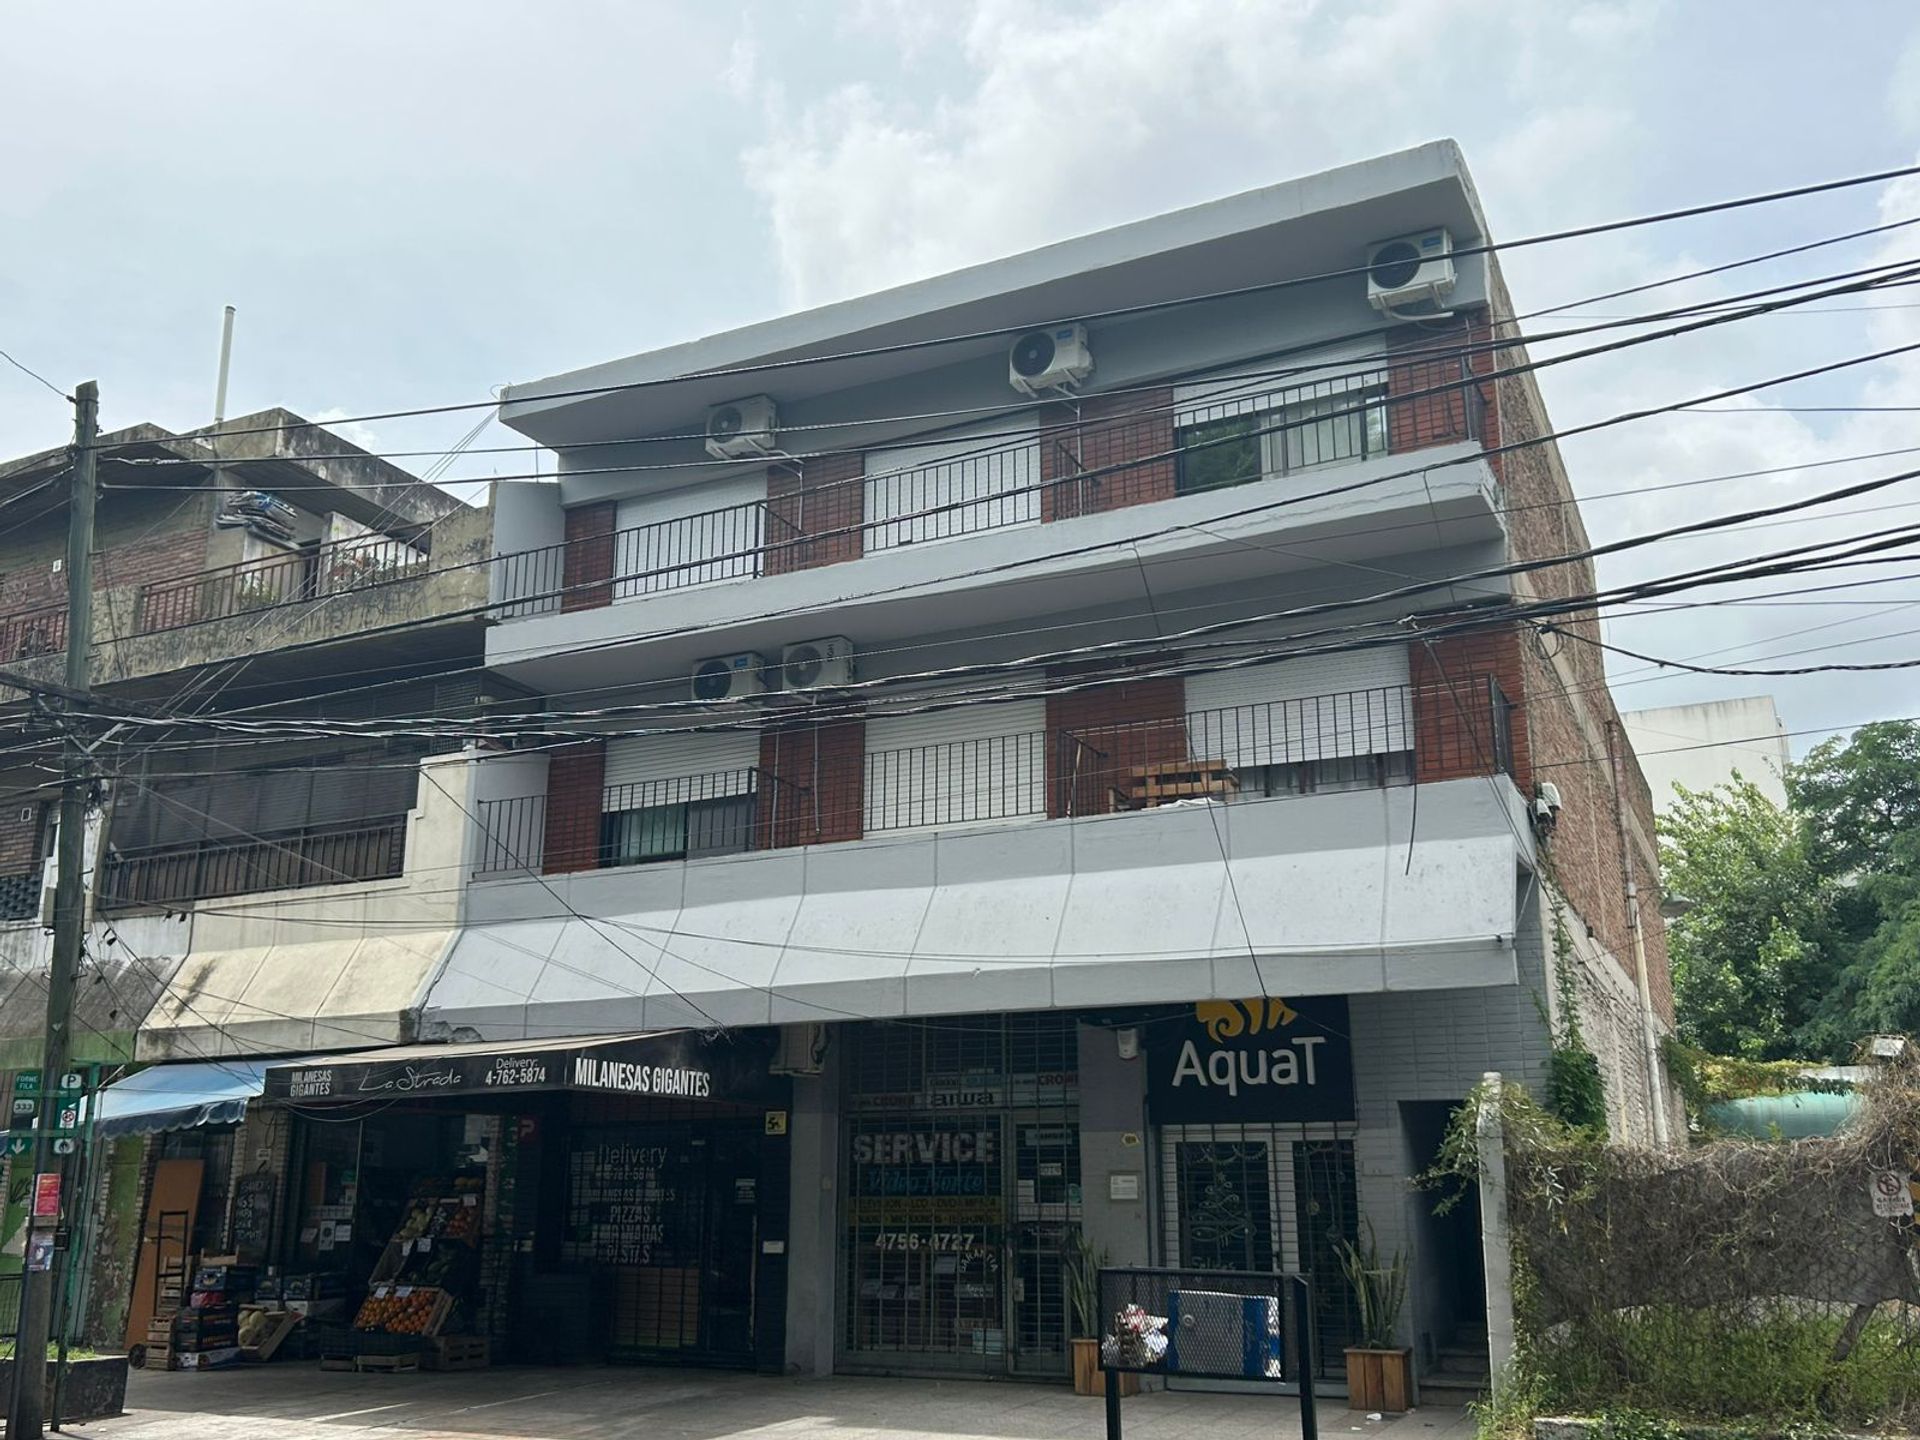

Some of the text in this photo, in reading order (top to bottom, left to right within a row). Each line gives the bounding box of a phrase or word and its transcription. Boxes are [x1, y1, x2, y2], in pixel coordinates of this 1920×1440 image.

[496, 1057, 539, 1071] Delivery:
[1171, 1036, 1327, 1096] AquaT
[290, 1069, 332, 1083] MILANESAS
[358, 1065, 462, 1091] La Strada
[485, 1067, 546, 1085] 4-762-5874
[575, 1056, 711, 1097] MILANESAS GIGANTES
[290, 1082, 331, 1098] GIGANTES
[931, 1092, 995, 1106] aiwa
[598, 1143, 668, 1168] Delivery
[852, 1132, 995, 1164] SERVICE
[610, 1206, 651, 1224] PIZZAS
